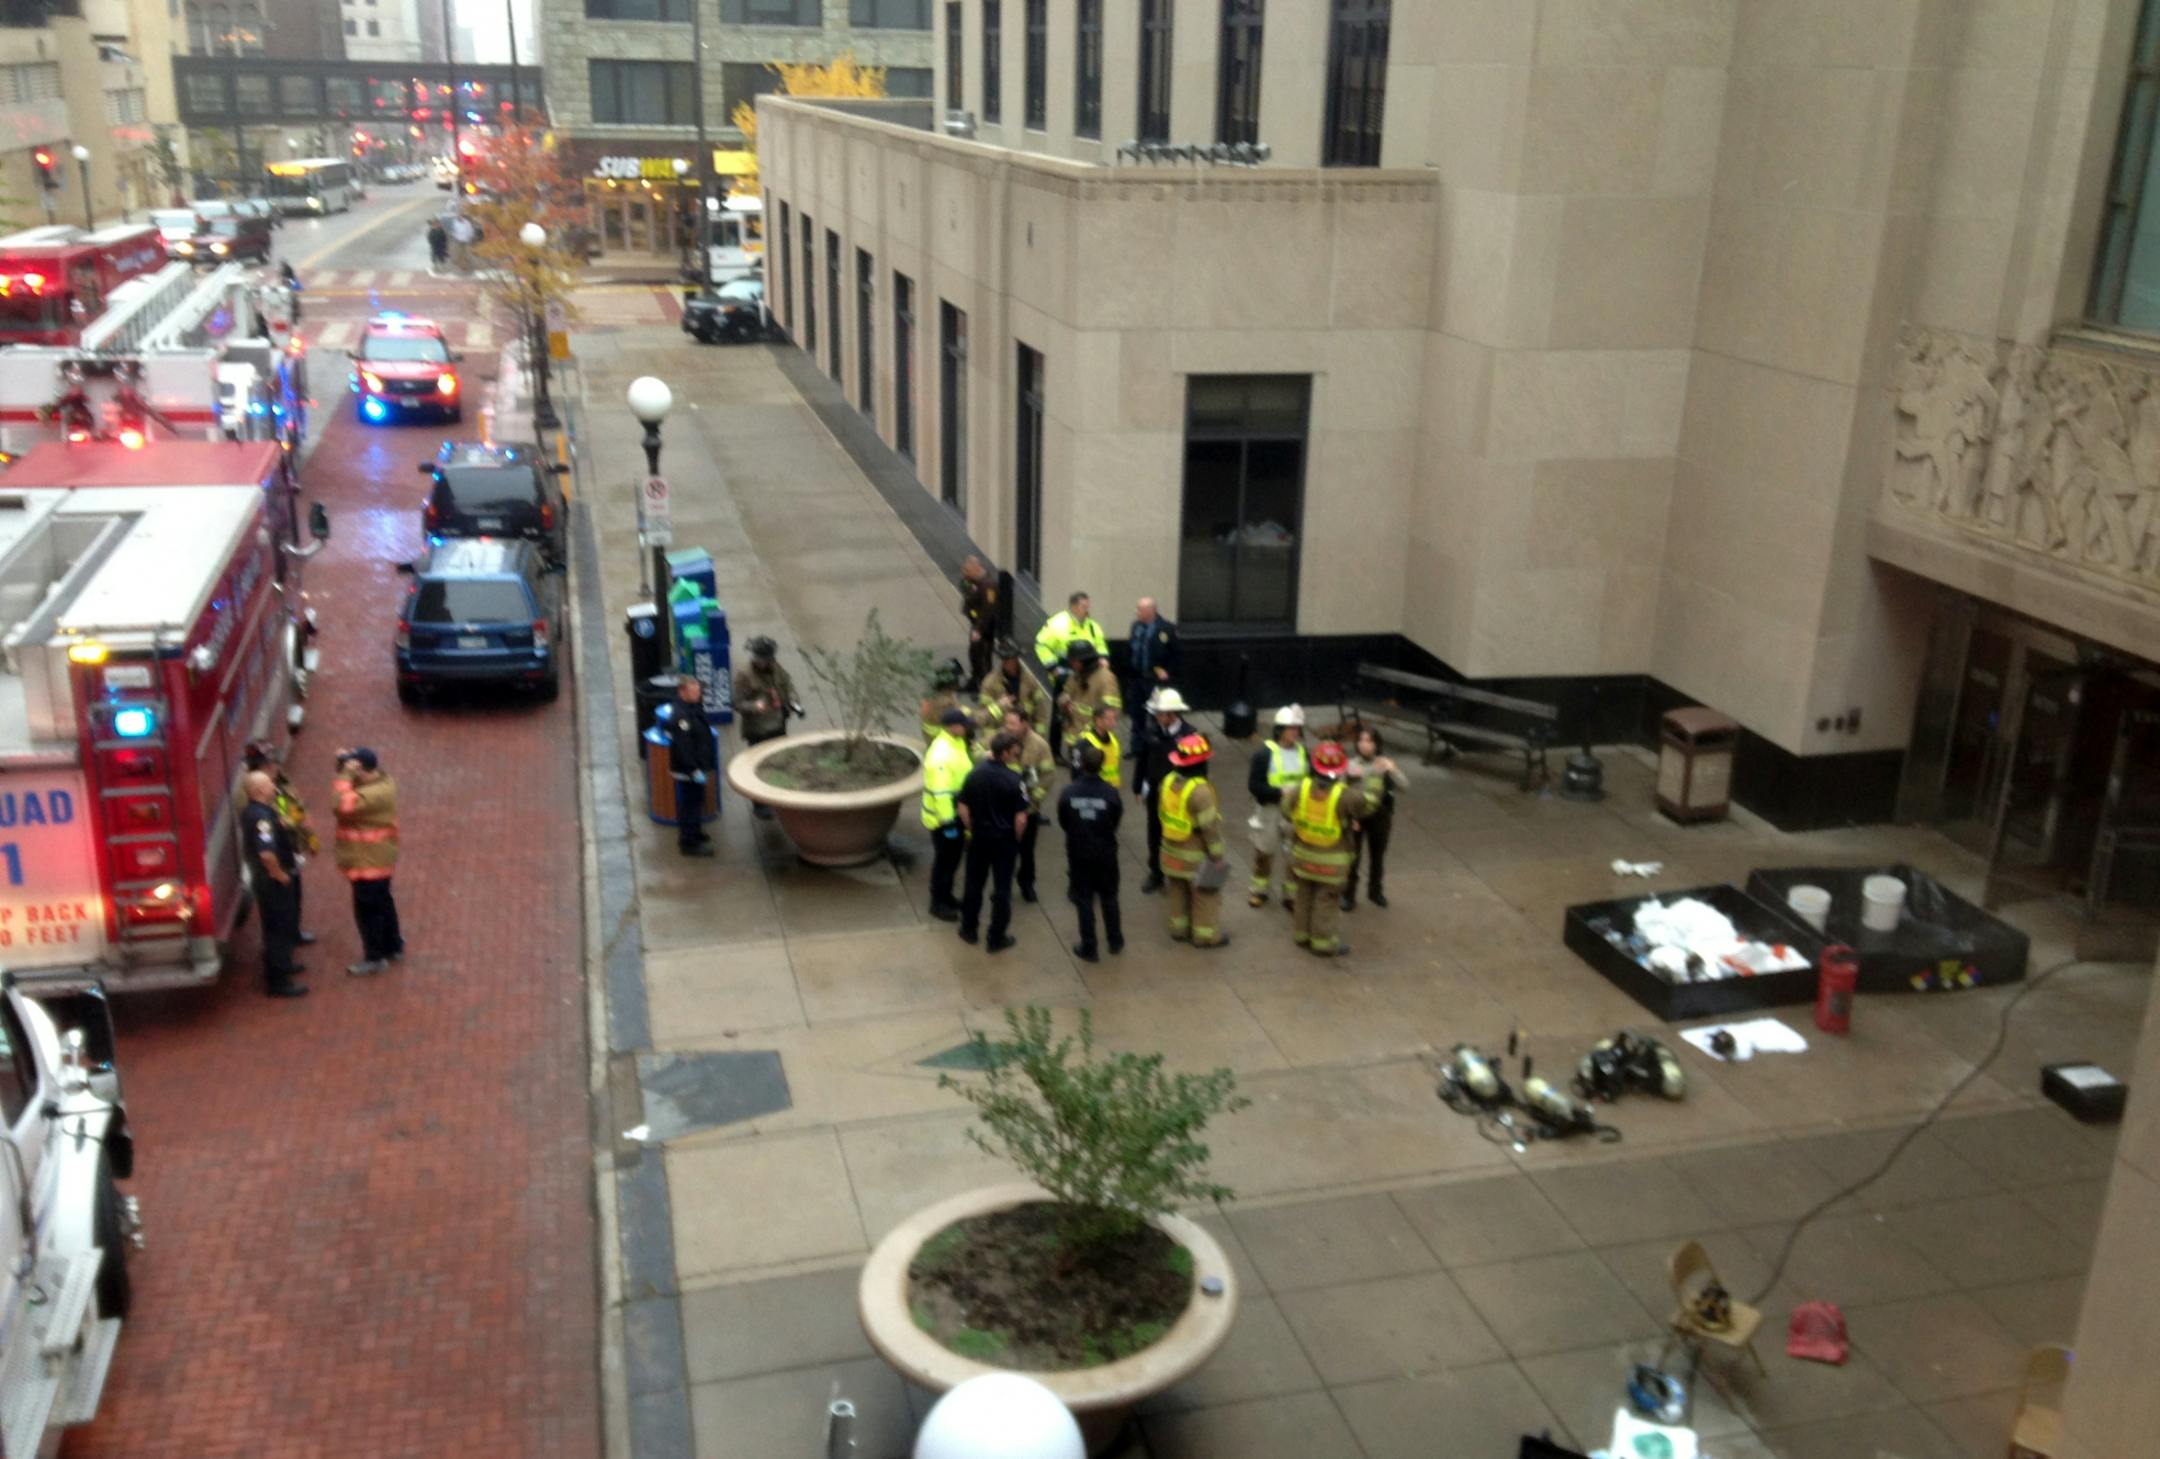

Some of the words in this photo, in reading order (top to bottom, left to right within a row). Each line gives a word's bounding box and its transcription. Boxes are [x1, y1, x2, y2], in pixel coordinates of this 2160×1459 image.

[594, 156, 692, 179] SUB
[26, 903, 87, 923] BACK
[26, 923, 80, 945] FEET
